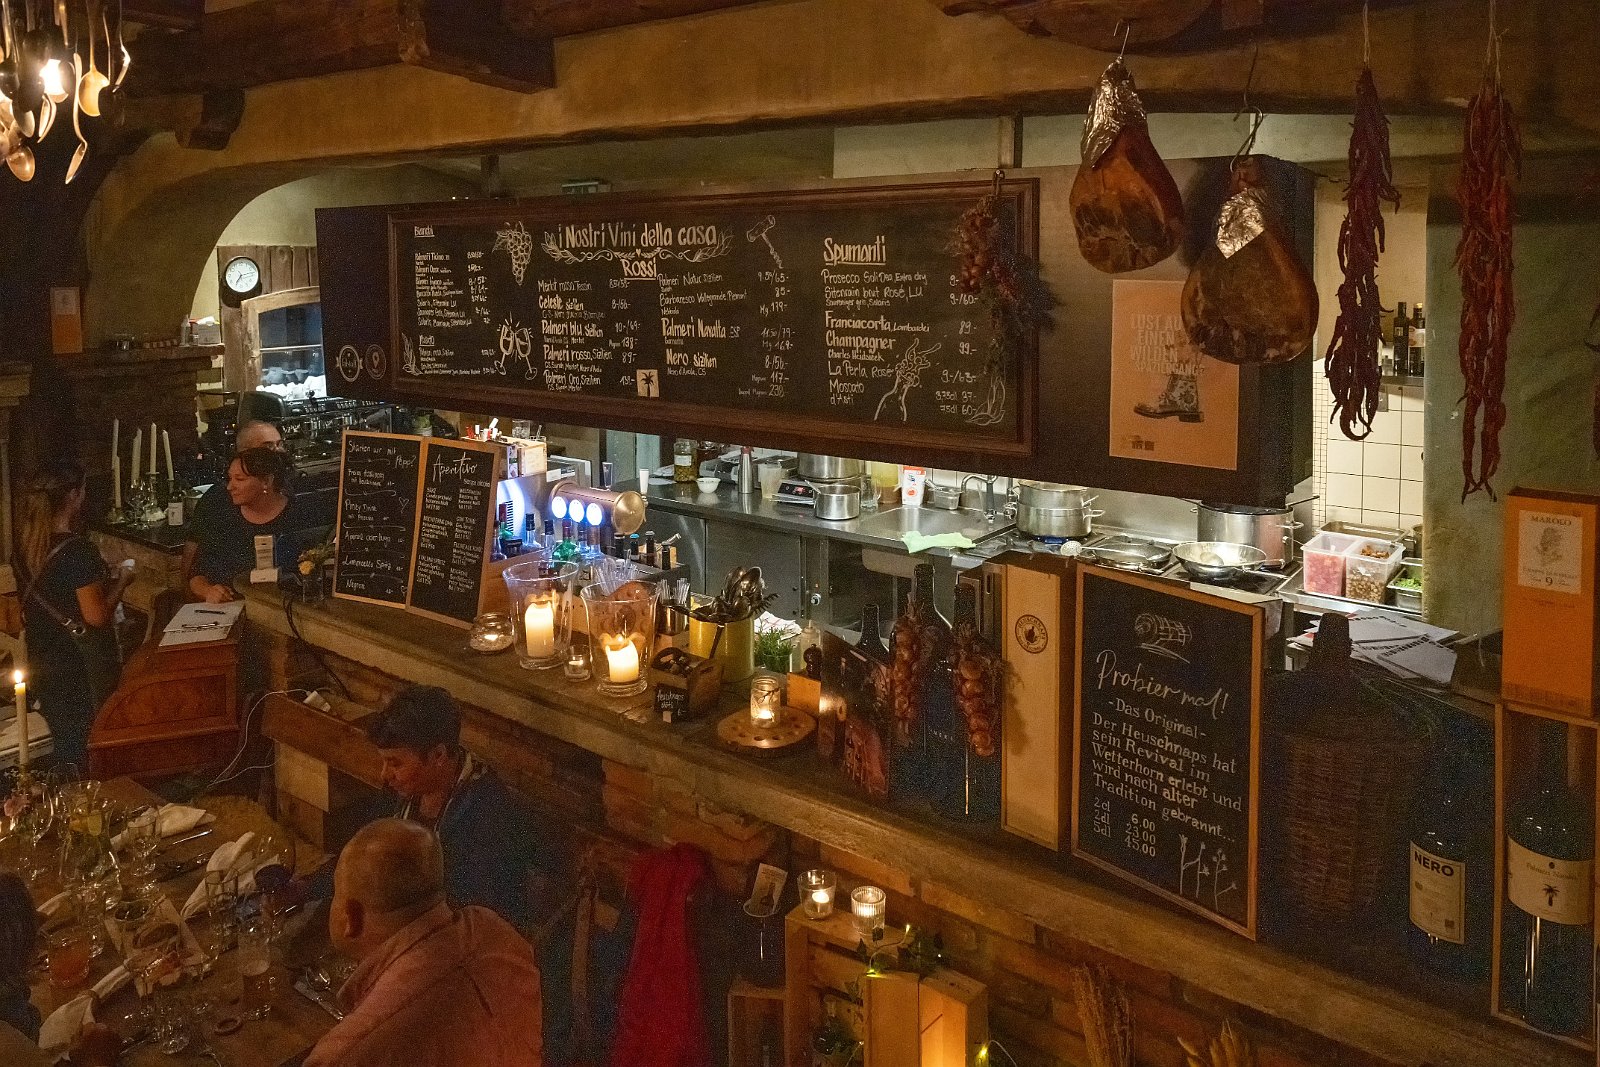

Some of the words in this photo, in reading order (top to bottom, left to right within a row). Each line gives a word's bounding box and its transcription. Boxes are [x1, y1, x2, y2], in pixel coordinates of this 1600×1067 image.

[565, 222, 606, 248] Nostri
[607, 222, 636, 248] Vini
[640, 222, 673, 247] della
[677, 225, 718, 246] casa
[824, 235, 887, 266] Spumanti
[620, 256, 657, 278] Rossi
[820, 268, 860, 284] Prosecco
[914, 271, 928, 286] dry
[656, 273, 680, 288] Palmeri
[660, 292, 696, 307] Barbaresco
[541, 320, 569, 336] Palmeri
[660, 316, 695, 338] Palmeri
[1130, 313, 1162, 331] LUST
[1165, 314, 1183, 331] AU
[826, 330, 897, 354] Champagner
[1138, 329, 1175, 346] EINEN
[543, 344, 569, 362] Palmeri
[666, 348, 690, 366] Nero
[1130, 344, 1178, 362] WILDEN
[828, 360, 844, 376] La
[842, 360, 869, 378] Perla
[829, 378, 865, 394] Moscato
[432, 451, 478, 483] Aperitivo
[1096, 649, 1181, 699] Probier
[1181, 688, 1229, 720] mal!
[1092, 712, 1117, 732] Der
[1122, 722, 1207, 764] Heuschnaps
[1213, 753, 1236, 774] hat
[1092, 730, 1122, 748] sein
[1125, 737, 1184, 772] Revival
[1190, 764, 1211, 784] im
[1091, 741, 1165, 783] Wetterhorn
[1168, 776, 1209, 799] erlebt
[1212, 792, 1242, 812] und
[1092, 759, 1122, 780] wird
[1124, 772, 1159, 796] nach
[1162, 788, 1199, 810] alter
[1092, 772, 1156, 812] Tradition
[1132, 814, 1156, 832] 6.00
[1414, 851, 1455, 877] NERO
